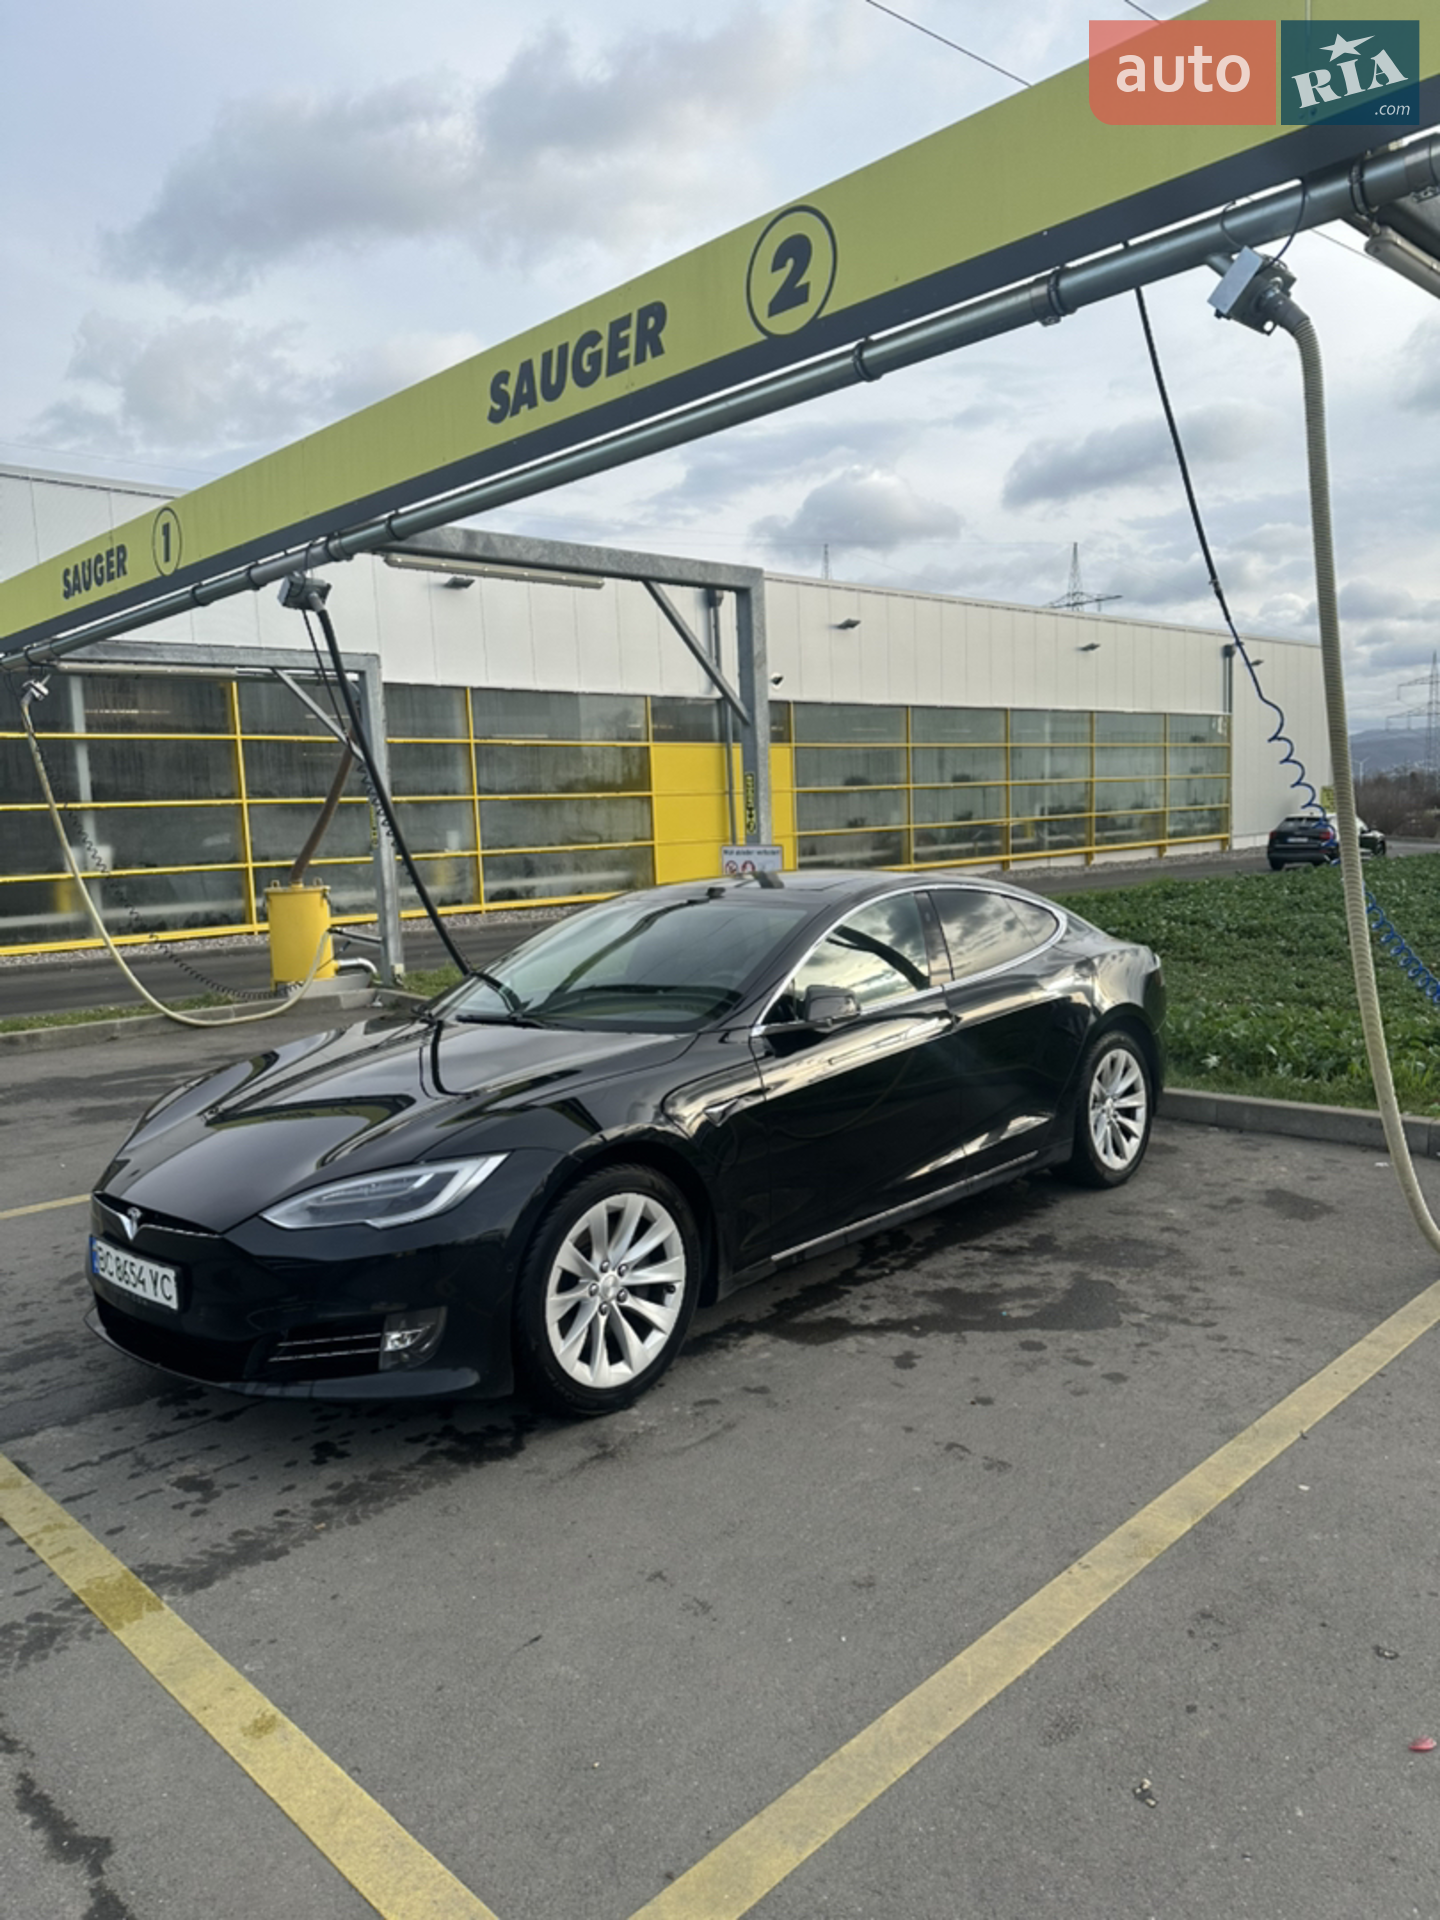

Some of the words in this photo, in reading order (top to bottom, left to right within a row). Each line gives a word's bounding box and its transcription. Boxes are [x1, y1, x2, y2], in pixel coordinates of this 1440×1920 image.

[487, 301, 668, 424] SAUGER
[767, 233, 813, 320] 2
[62, 544, 128, 600] SAUGER
[162, 522, 171, 563] 1
[115, 1256, 147, 1293] 8654
[149, 1268, 173, 1301] YC
